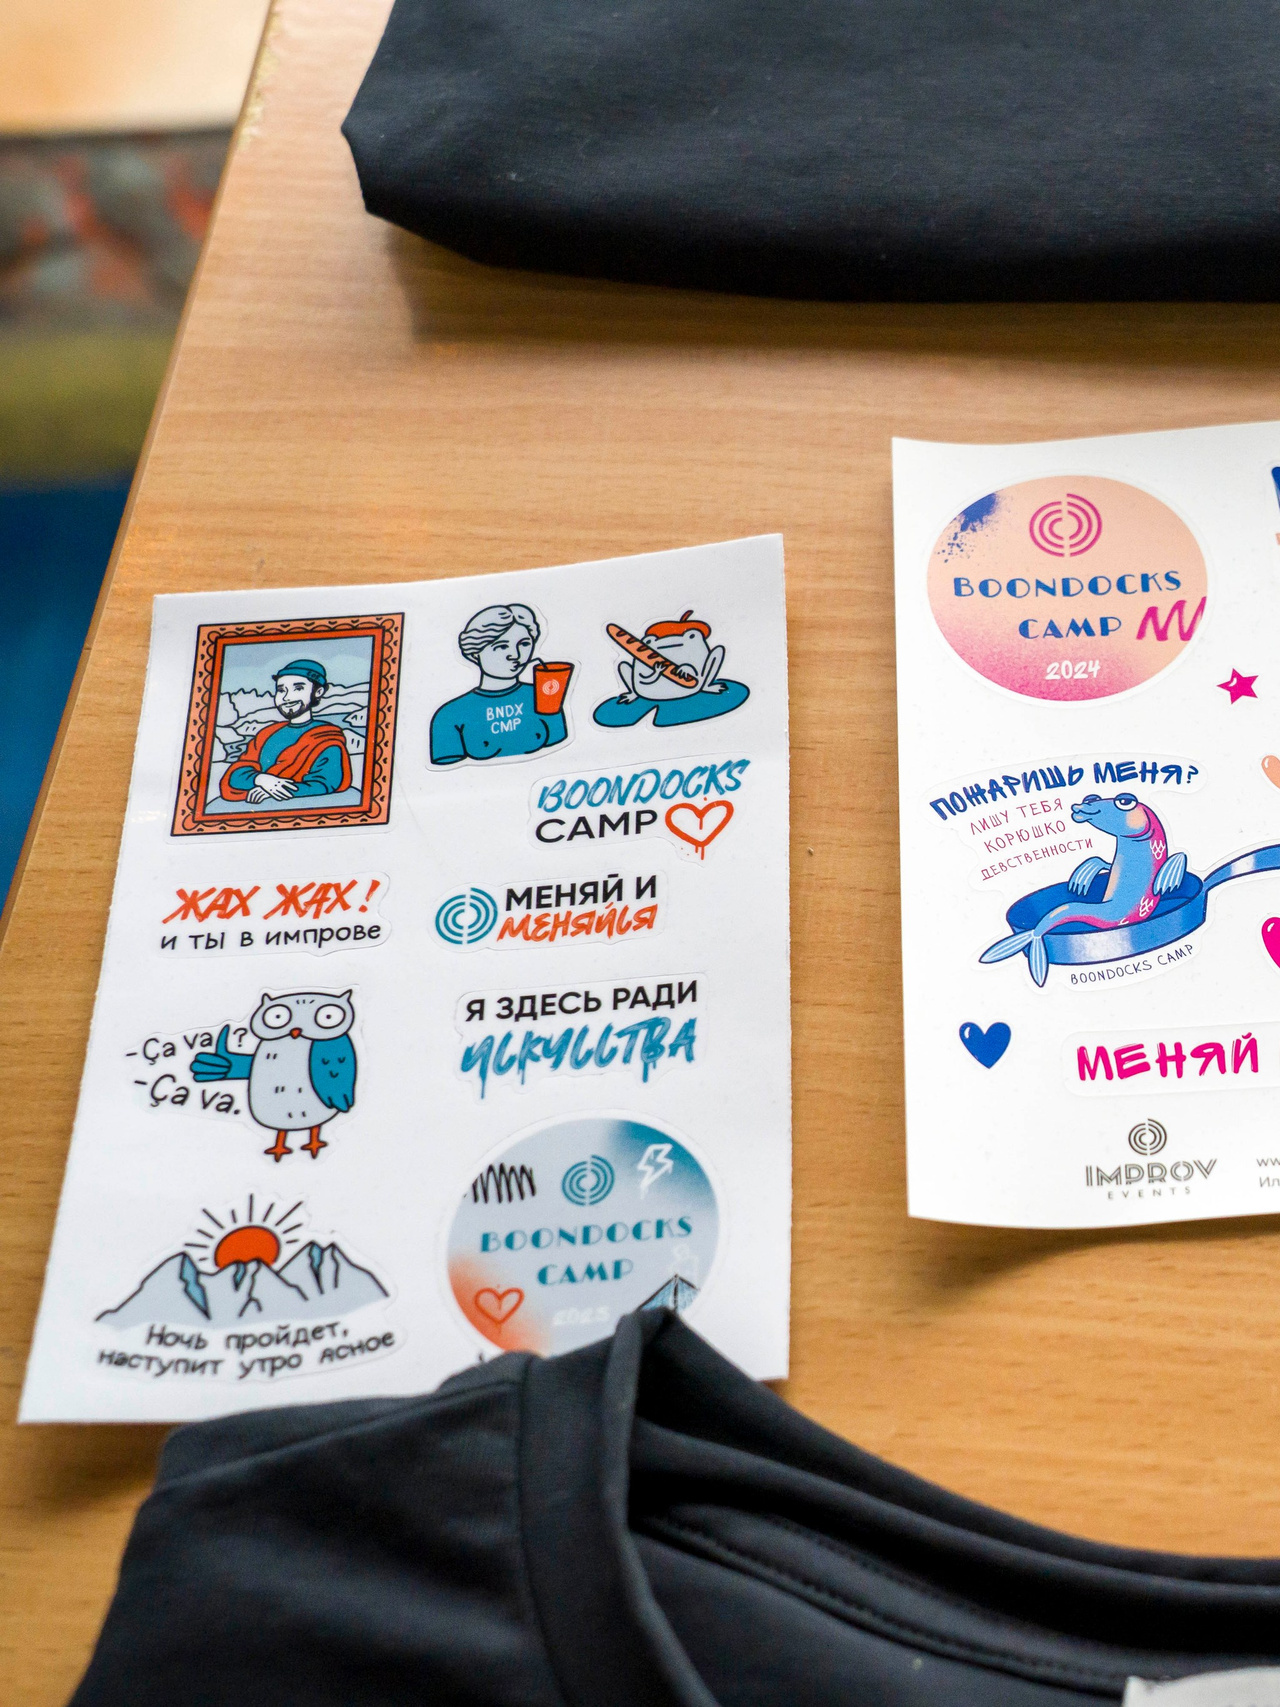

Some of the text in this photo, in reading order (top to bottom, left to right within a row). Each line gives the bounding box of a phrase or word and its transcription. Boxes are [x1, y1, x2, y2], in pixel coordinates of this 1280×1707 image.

[953, 570, 1182, 599] BOONDOCKS
[1018, 616, 1122, 640] CAMP
[1044, 659, 1101, 681] 2024
[486, 703, 524, 721] BNDX
[490, 718, 522, 734] CMP
[537, 759, 751, 813] BOONDOCKS
[929, 761, 1199, 821] ПОЖАРИШЬ МЕНЯ?
[535, 809, 659, 843] CAMP
[969, 797, 1064, 836] ЛИШУ ТЕБЯ
[983, 820, 1067, 853] КОРЮШКО
[980, 838, 1094, 881] ДЕВСТВЕННОСТИ
[161, 886, 261, 924] ЖАХ
[505, 873, 657, 911] МЕНЯЙ И
[160, 924, 382, 950] и ты в импрове
[496, 902, 658, 942] МЕНЯЙСЯ
[1070, 943, 1195, 985] BOONDOCKS CAMP
[465, 980, 698, 1022] Я ЗДЕСЬ РАДИ
[461, 1015, 698, 1100] ИСКУССТВА
[1077, 1031, 1259, 1081] МЕНЯЙ
[201, 1088, 240, 1116] va.
[1085, 1159, 1218, 1186] IMPROV
[1107, 1185, 1191, 1200] EVENTS
[480, 1216, 693, 1253] BOONDOCKS
[536, 1258, 634, 1286] CAMP
[145, 1321, 350, 1354] Ночь пройдет,
[97, 1331, 397, 1380] наступит утро ясное
